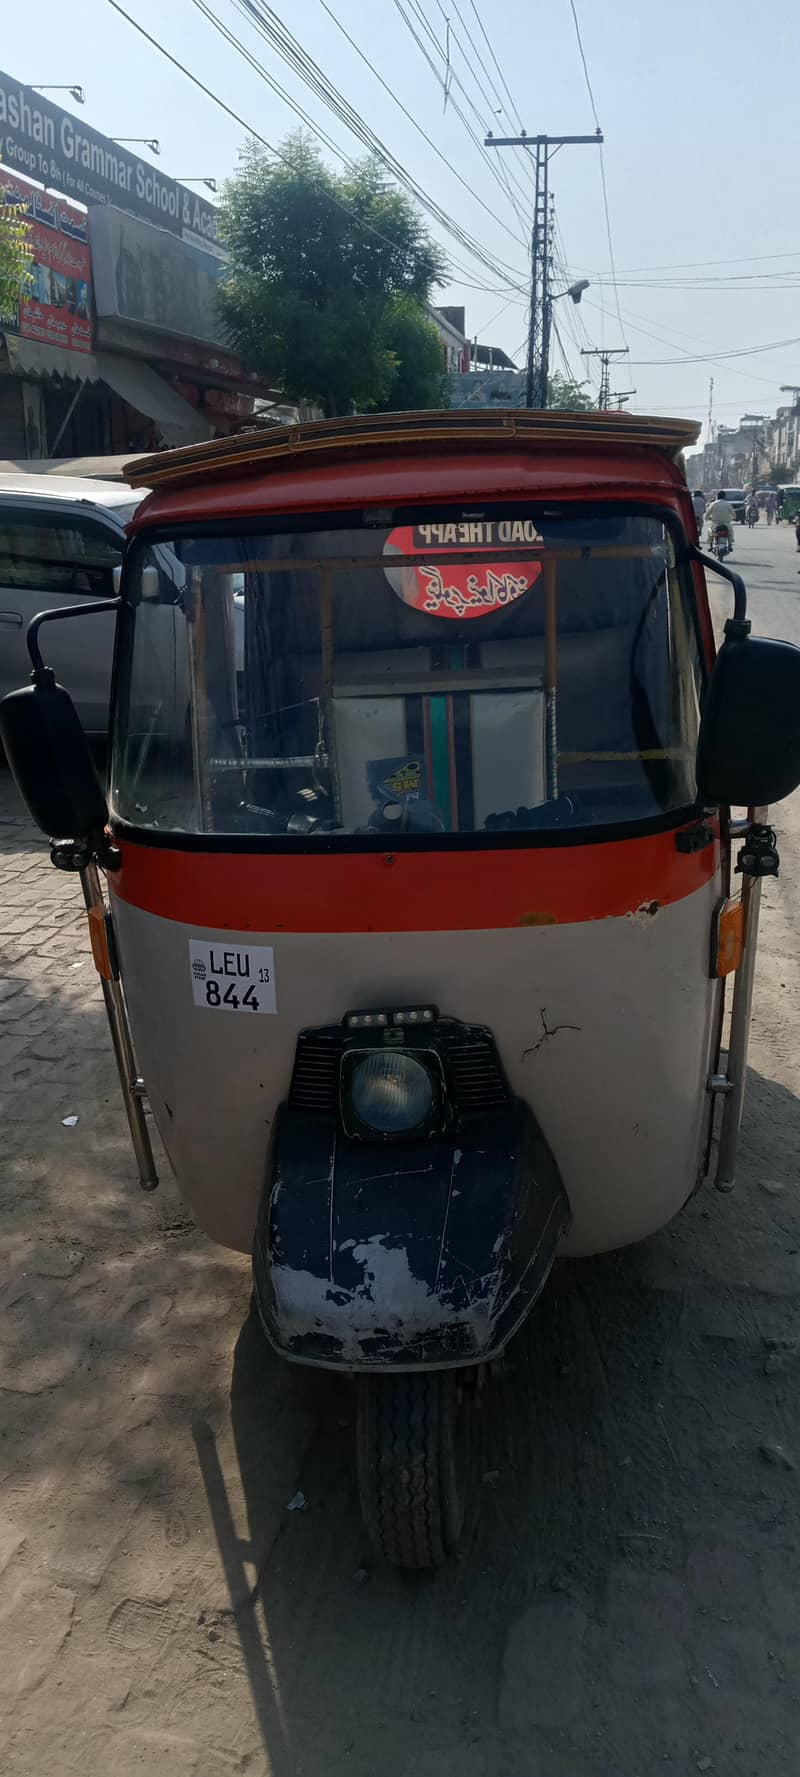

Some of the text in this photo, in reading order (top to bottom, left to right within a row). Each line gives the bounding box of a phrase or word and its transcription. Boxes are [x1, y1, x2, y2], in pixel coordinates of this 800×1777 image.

[5, 136, 36, 169] Group
[38, 154, 49, 174] To
[61, 117, 132, 192] Grammar
[136, 163, 179, 219] School
[182, 190, 191, 224] &
[209, 949, 250, 978] LEU
[258, 967, 270, 983] 13
[206, 980, 260, 1011] 844
